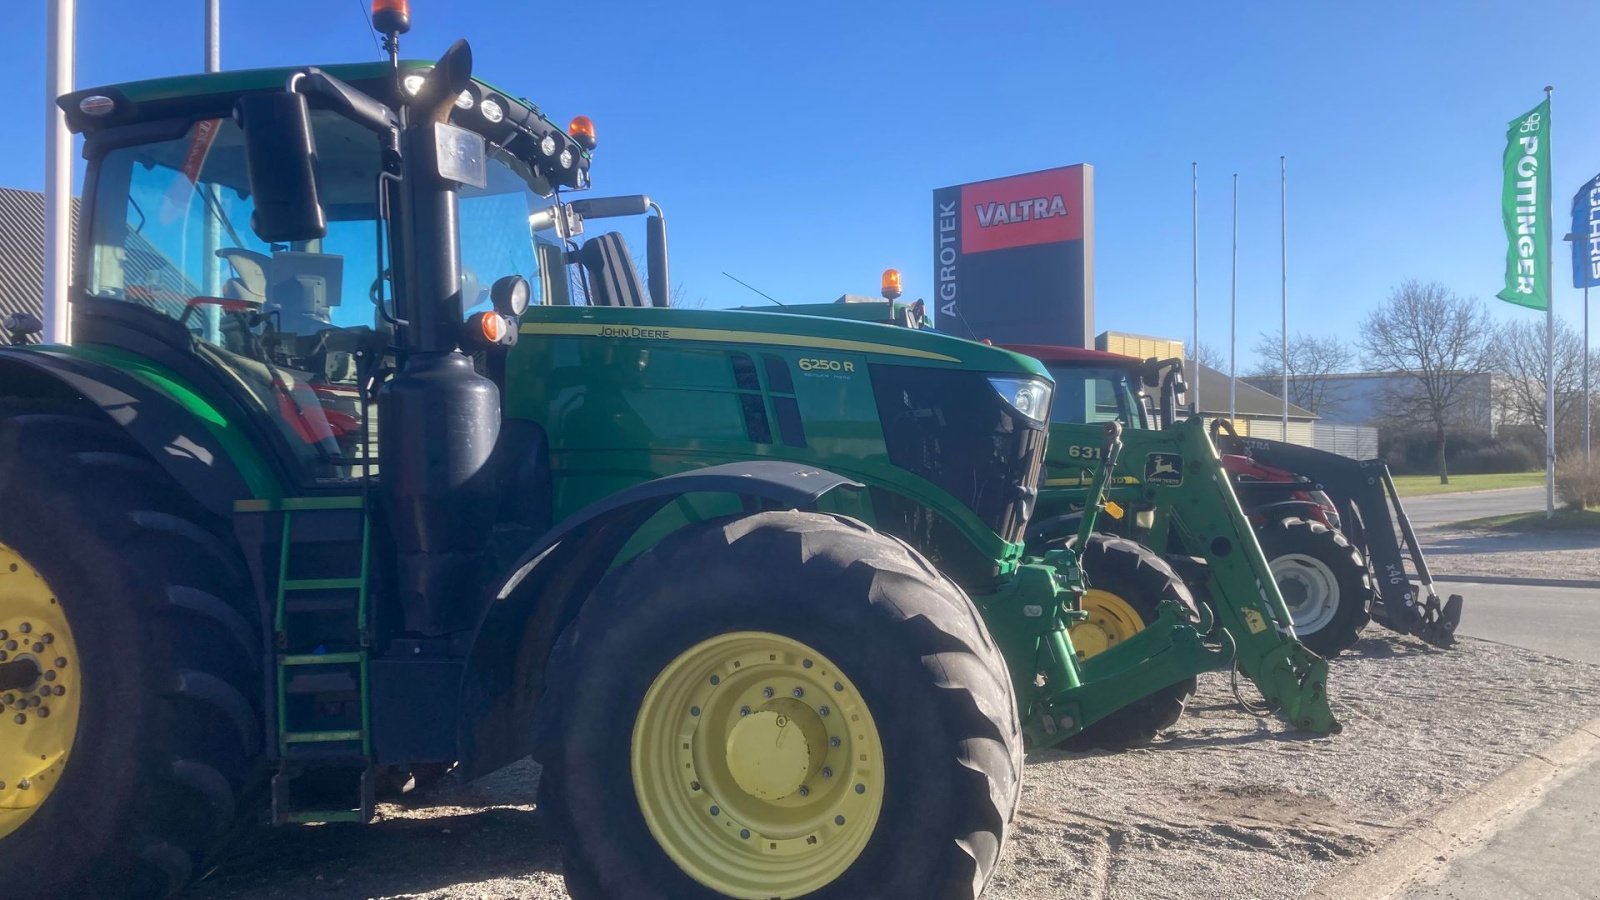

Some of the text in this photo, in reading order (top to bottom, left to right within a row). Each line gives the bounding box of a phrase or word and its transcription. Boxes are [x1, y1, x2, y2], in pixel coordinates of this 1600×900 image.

[974, 194, 1069, 229] VALTRA
[939, 200, 957, 318] AGROTEK
[598, 325, 670, 339] JOHN DEERE
[798, 358, 855, 373] 6250 R
